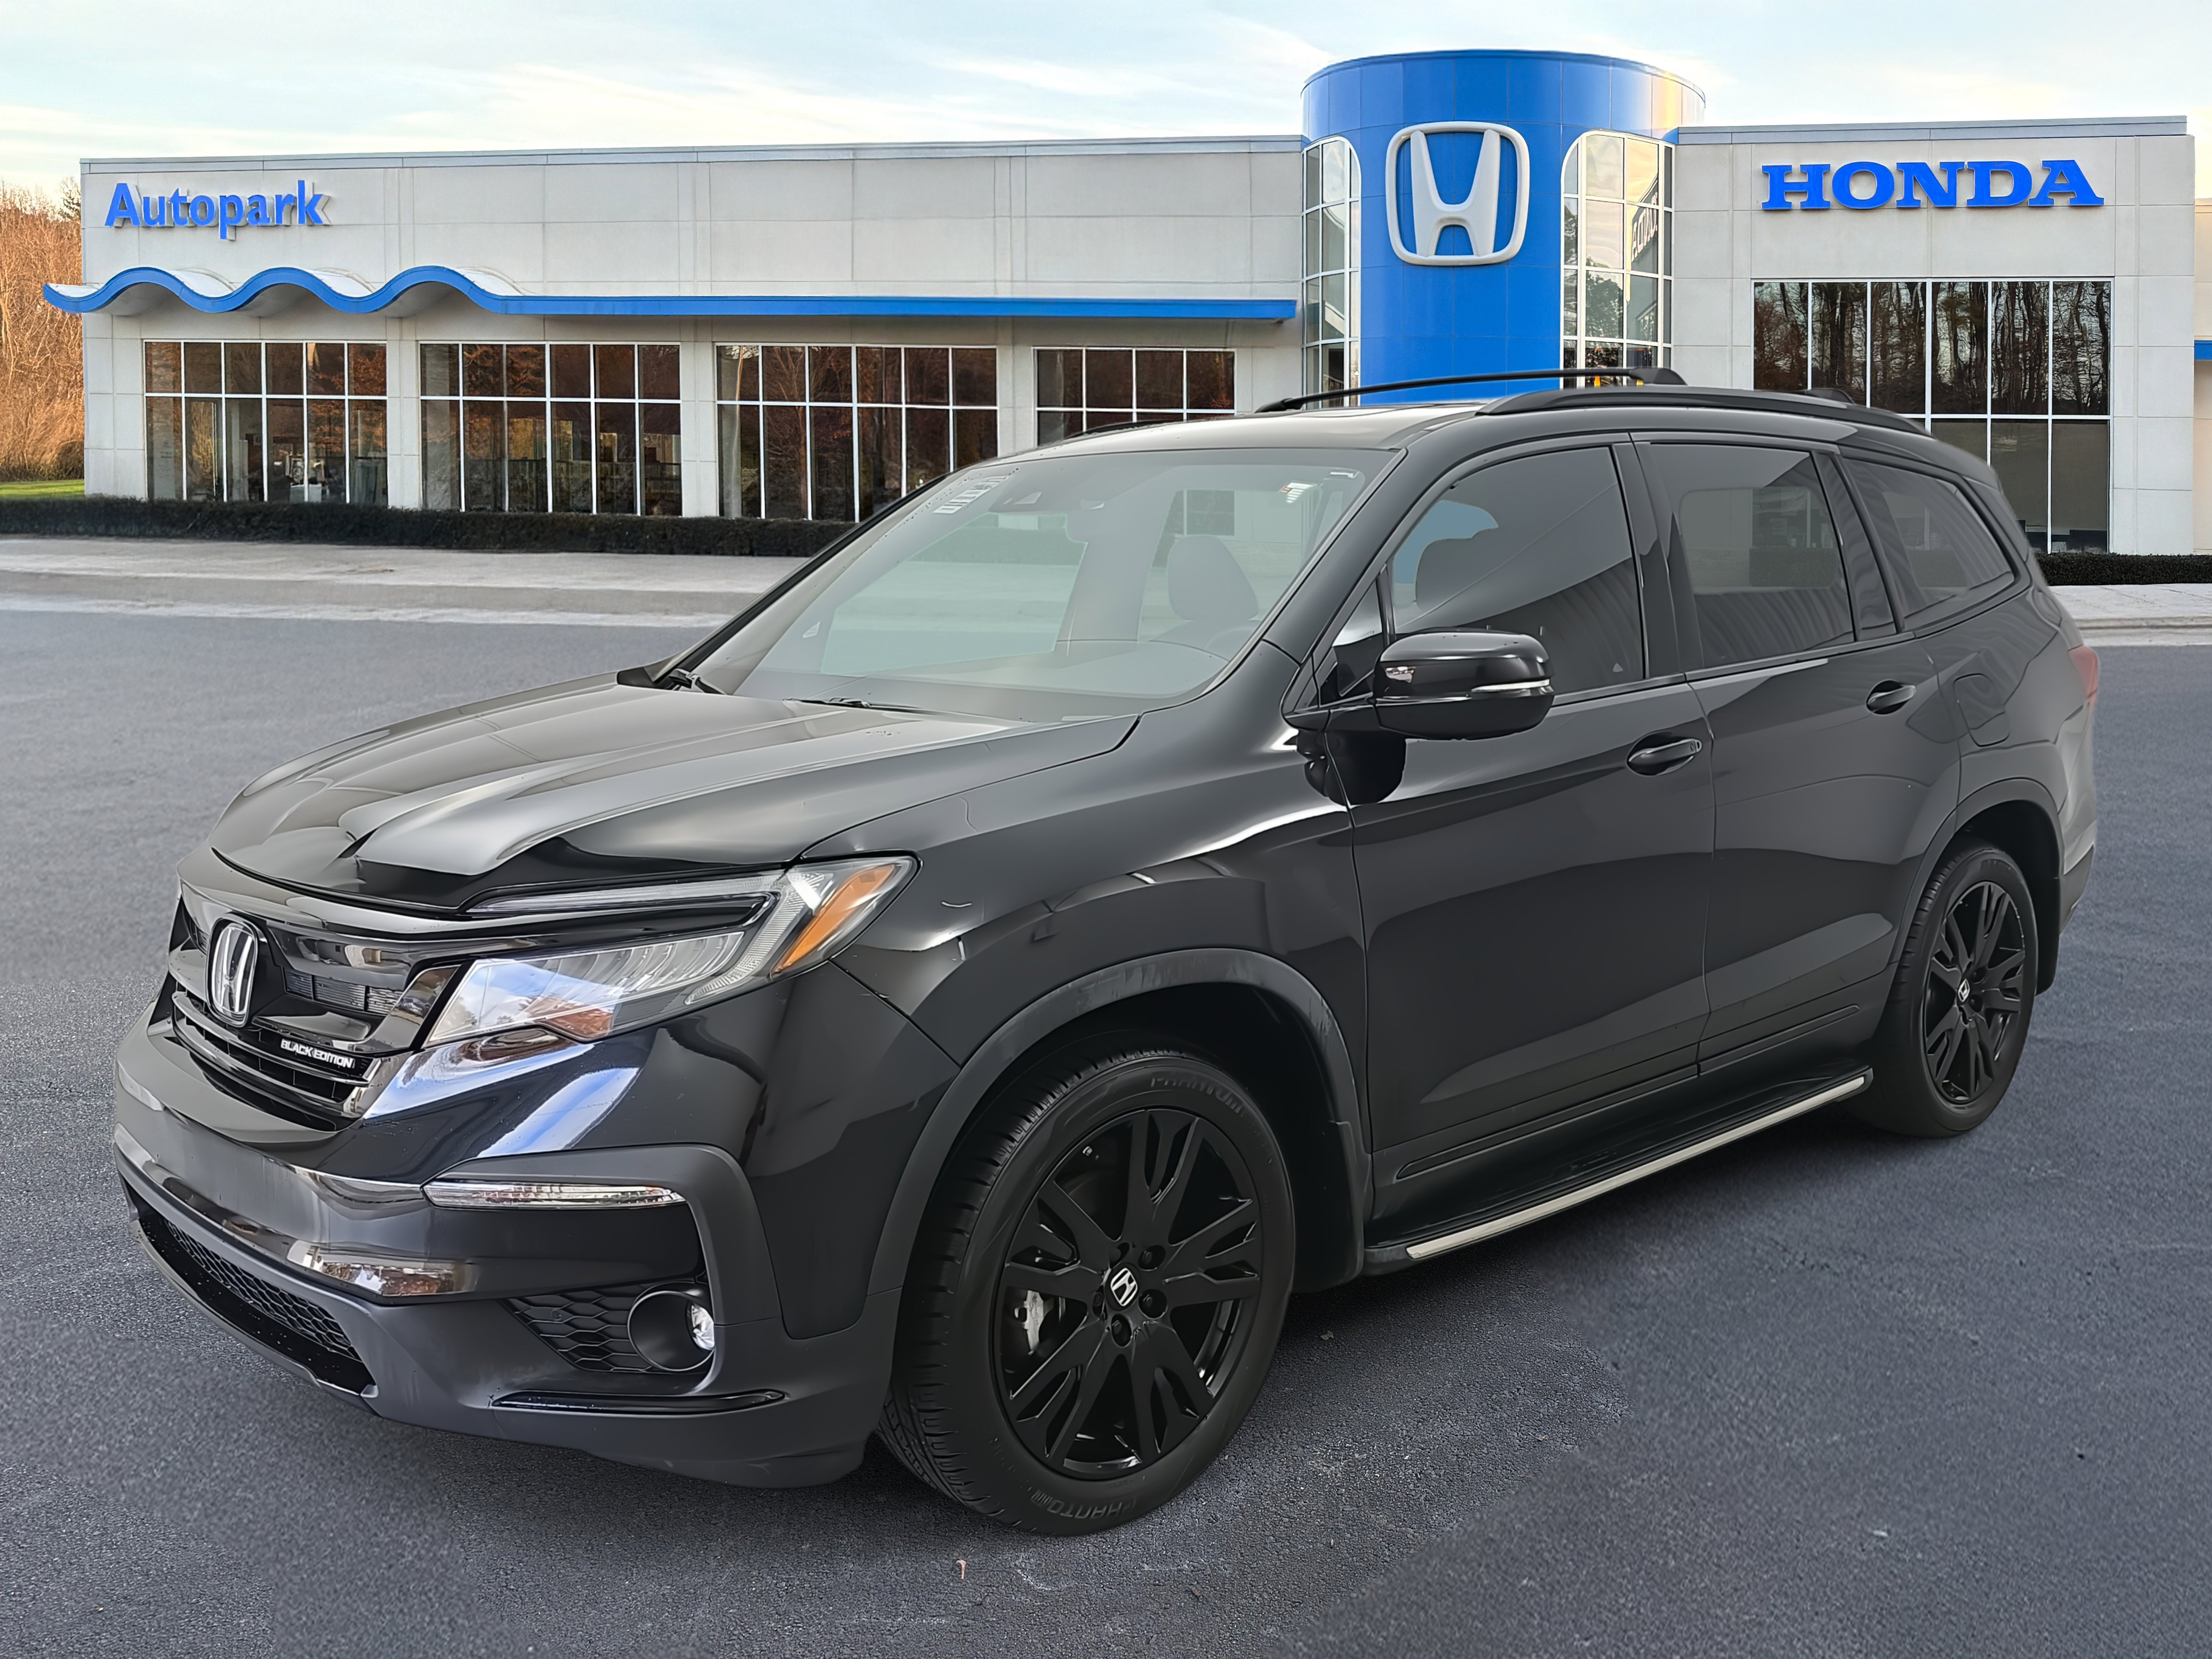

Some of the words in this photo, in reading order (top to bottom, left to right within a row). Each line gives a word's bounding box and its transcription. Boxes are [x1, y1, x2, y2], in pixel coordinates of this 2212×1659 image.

[105, 180, 326, 240] Autopark
[1761, 159, 2105, 210] HONDA
[280, 1038, 314, 1058] BLACK
[313, 1048, 356, 1069] EDITION
